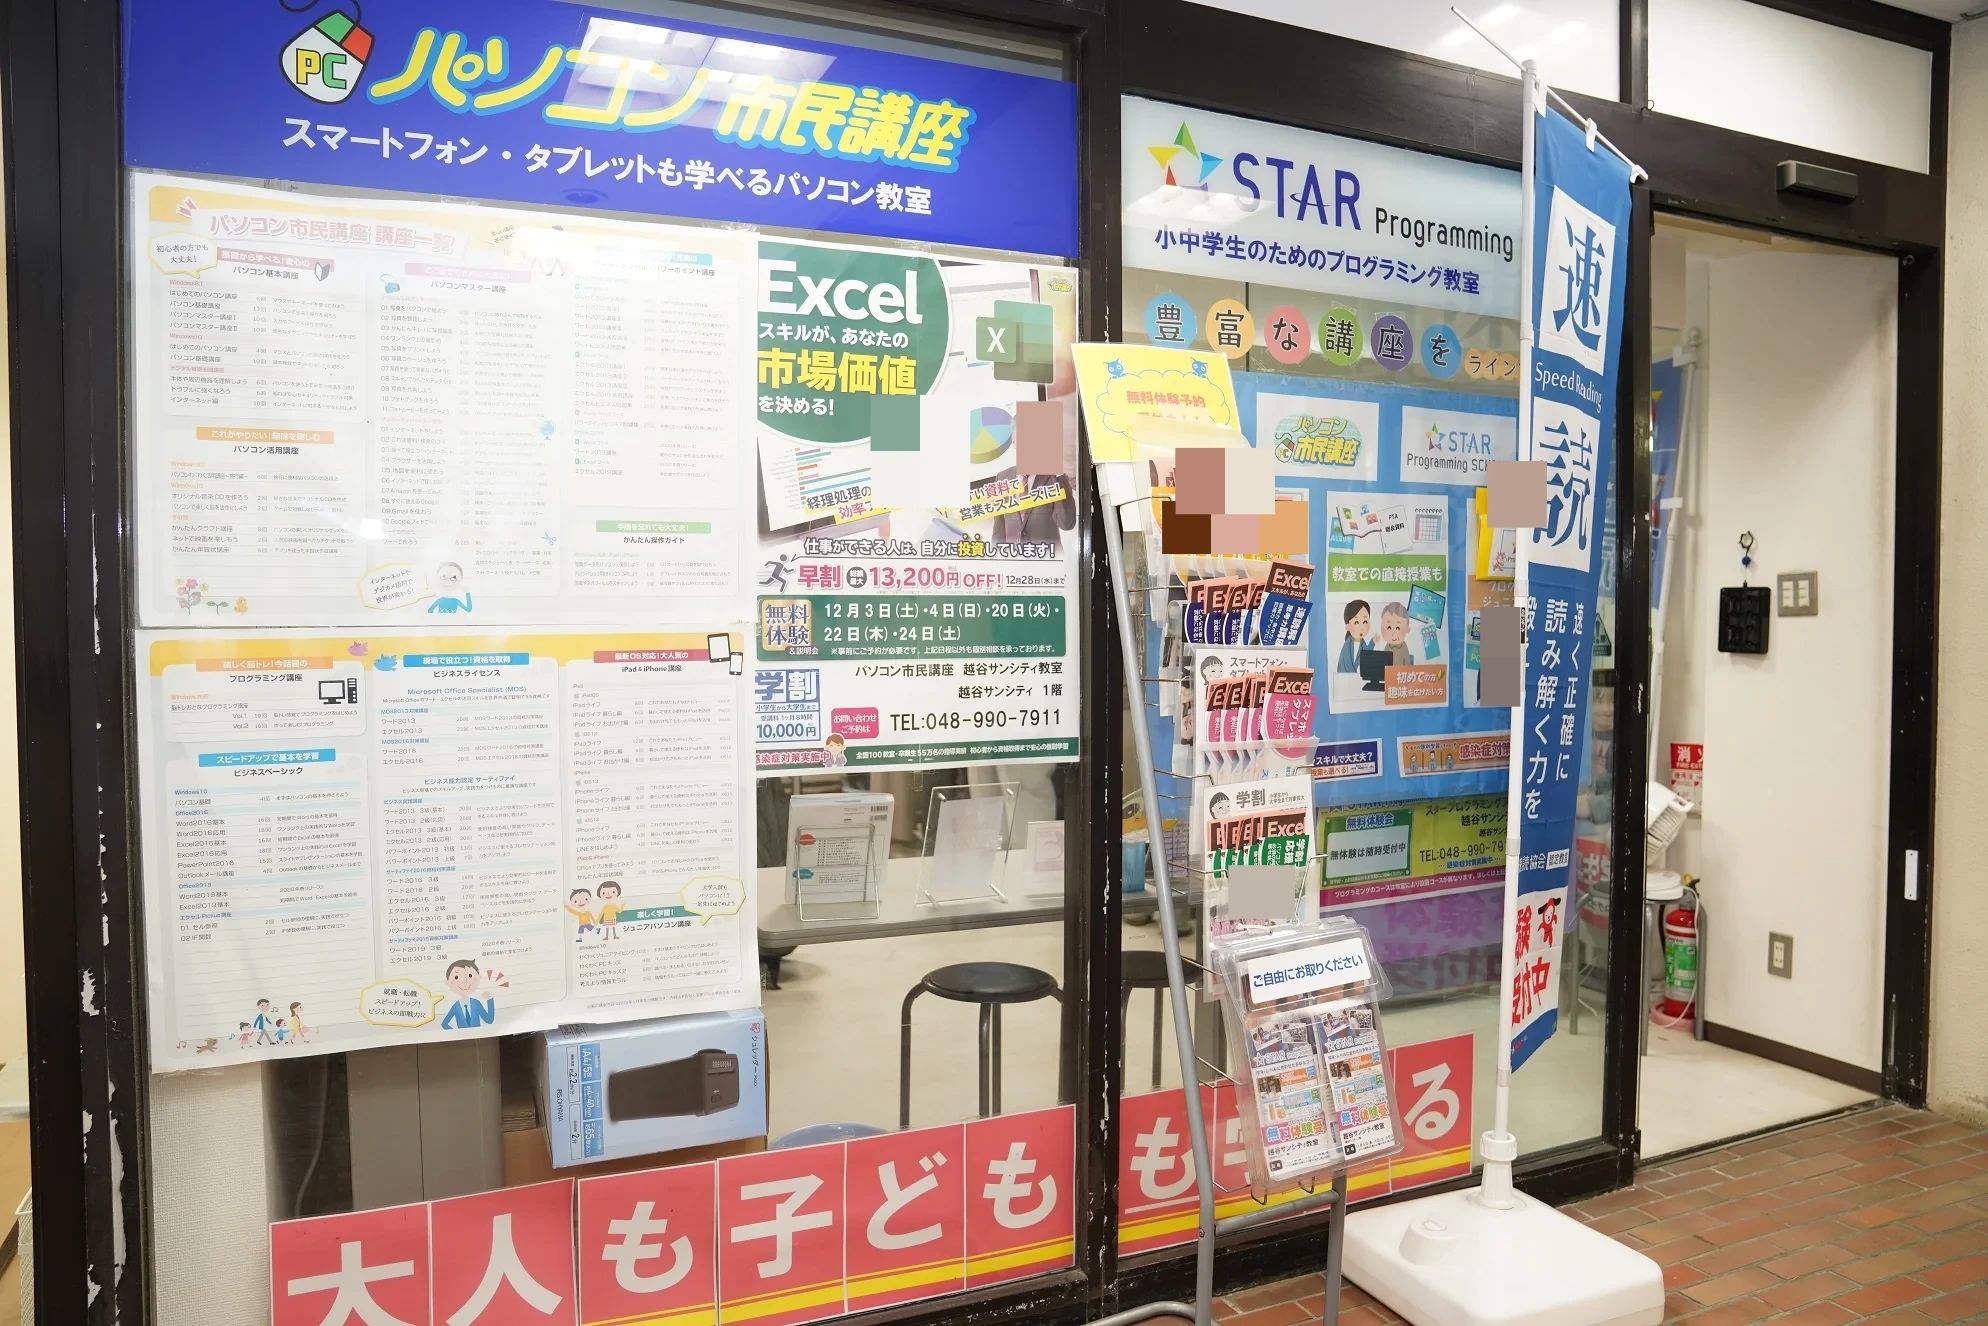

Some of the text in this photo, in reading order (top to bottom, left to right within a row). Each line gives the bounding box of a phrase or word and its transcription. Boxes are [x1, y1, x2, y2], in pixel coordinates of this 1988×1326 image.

[294, 49, 347, 89] PC
[370, 29, 973, 165] パソコン市民講座
[283, 115, 932, 216] スマートフォン・タブレットも学べるパソコン教室
[1232, 152, 1514, 263] STAR Programming
[210, 214, 455, 254] パソコン市民講座 講座一覧
[1155, 224, 1480, 295] 小中学生のためのプログラミング教室
[758, 258, 923, 324] Excel
[759, 322, 909, 348] スキルが、あなたの
[758, 348, 917, 395] 市場価値
[1468, 354, 1520, 379] ライン
[1535, 360, 1602, 413] Speed Reading
[759, 396, 834, 416] を決める!
[1293, 416, 1348, 436] パソコン
[1294, 436, 1361, 467] 市民講座
[1448, 434, 1491, 455] STAR
[1406, 452, 1469, 474] Programming
[960, 484, 1061, 521] 営業もスムーズに!
[805, 538, 1055, 558] 仕事ができる人は、自分に投資しています!
[797, 565, 841, 588] 早割
[869, 566, 960, 588] 13,200円
[963, 573, 1003, 589] OFF!
[1332, 566, 1442, 582] 教室での直接授業も
[765, 603, 809, 625] 無料
[765, 626, 809, 646] 体験
[230, 674, 303, 682] プログラミング講座
[433, 670, 501, 678] ビジネスライセンス
[856, 661, 1063, 678] パソコン市民講座 越谷サンシティ教室
[1396, 670, 1436, 683] 初めての方
[755, 670, 817, 702] 学割
[958, 685, 1063, 699] 越谷サンシティ 1階
[1388, 686, 1443, 699] 趣味を広げたい方
[1556, 602, 1584, 781] 速く正確に
[833, 713, 877, 724] お問い合わせ
[1525, 599, 1568, 820] 読み解く力を
[757, 723, 816, 738] 10,000円
[840, 724, 871, 734] ご予約は
[890, 709, 1061, 732] TEL:048-990-7911
[216, 751, 319, 764] スピードアップで基本を学習
[234, 767, 303, 777] ビジネスベーシック
[476, 775, 516, 783] サーティファイ
[1236, 788, 1265, 808] 学割
[1346, 813, 1394, 830] 無料体験会
[1330, 843, 1406, 860] 無体験は随時受付中
[1419, 840, 1505, 862] TEL:048-990-79
[636, 909, 674, 919] 楽しく学習!
[623, 920, 691, 932] ジュニアパソコン講座
[1253, 954, 1364, 987] ご自由にお取りください
